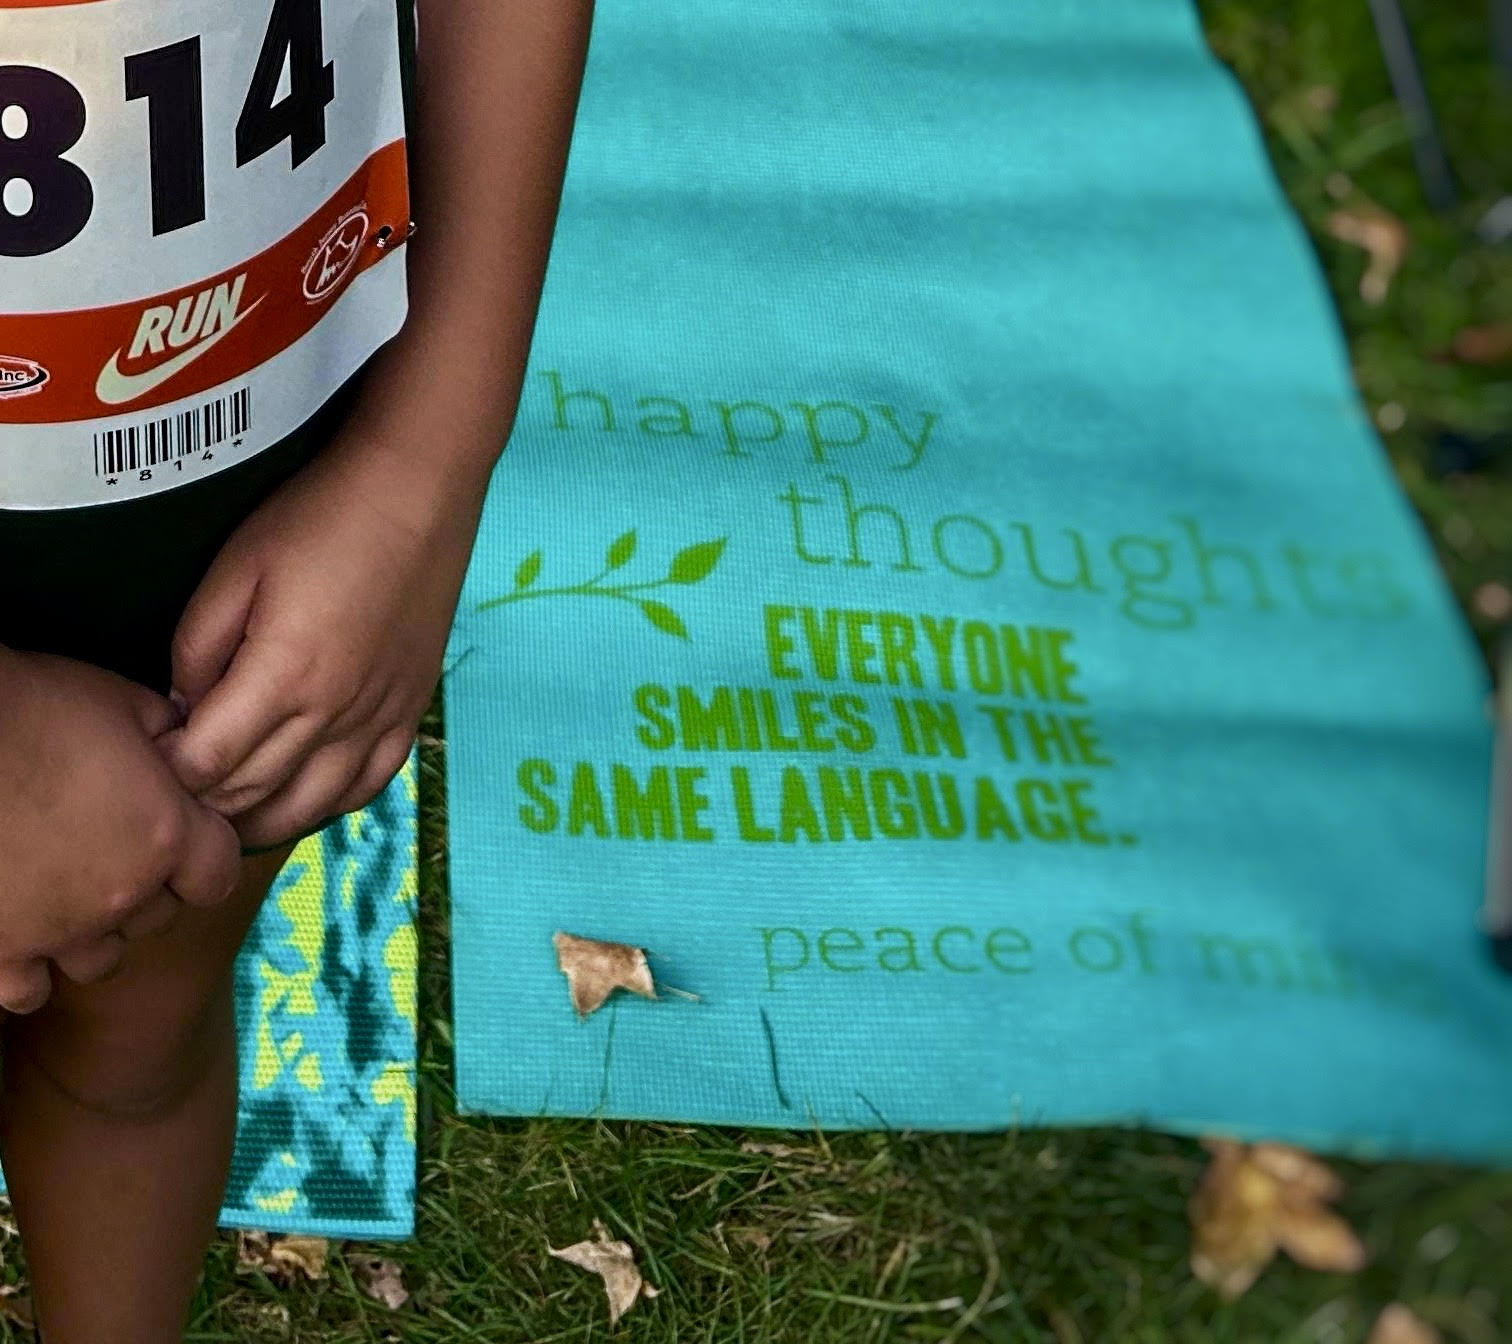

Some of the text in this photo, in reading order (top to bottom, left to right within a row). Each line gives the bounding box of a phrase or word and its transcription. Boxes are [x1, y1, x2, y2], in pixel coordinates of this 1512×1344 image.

[127, 272, 247, 359] RUN
[0, 369, 32, 382] Inc.
[540, 371, 941, 470] happy
[779, 475, 1416, 631] thoughts
[763, 604, 1088, 705] EVERYONE
[635, 683, 1112, 768] SMILES IN THE
[516, 758, 1140, 847] SAME LANGUAGE.
[759, 922, 1035, 991] peace
[1071, 908, 1160, 980] of
